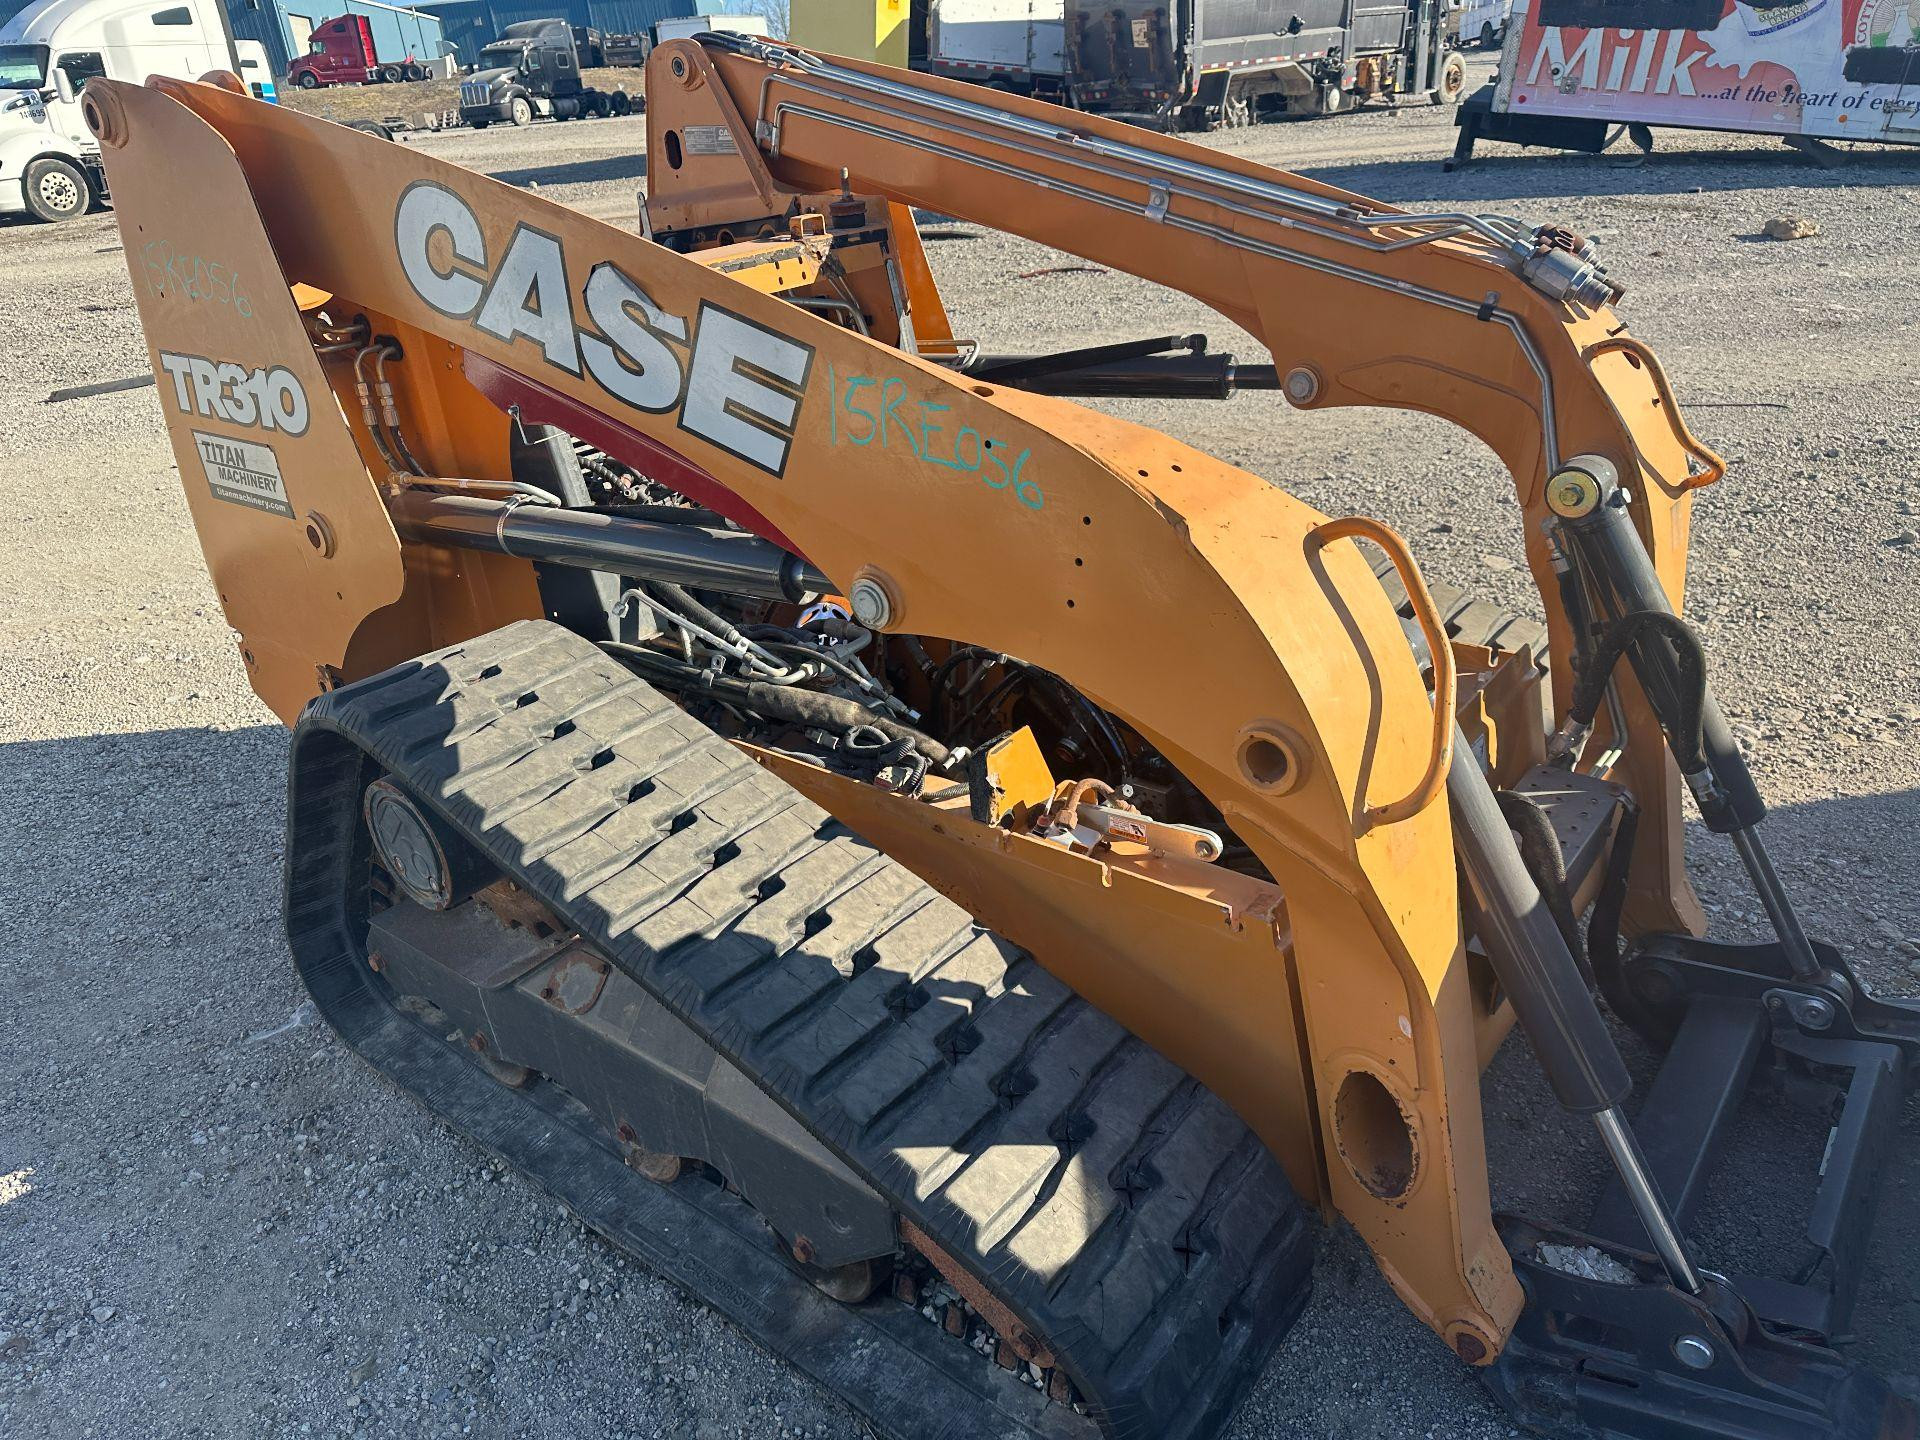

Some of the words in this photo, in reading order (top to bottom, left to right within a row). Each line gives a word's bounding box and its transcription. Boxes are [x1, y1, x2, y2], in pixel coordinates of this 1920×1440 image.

[1769, 5, 1808, 26] BANANA
[1526, 27, 1707, 96] Milk
[1745, 85, 1777, 103] the
[1781, 85, 1838, 108] heart
[1842, 91, 1868, 109] of
[394, 179, 816, 480] CASE
[159, 349, 310, 438] TR310
[828, 361, 1043, 510] 15RE056
[201, 440, 247, 469] TITAN
[217, 466, 277, 493] MACHINERY
[216, 487, 287, 512] titanmachinery.com
